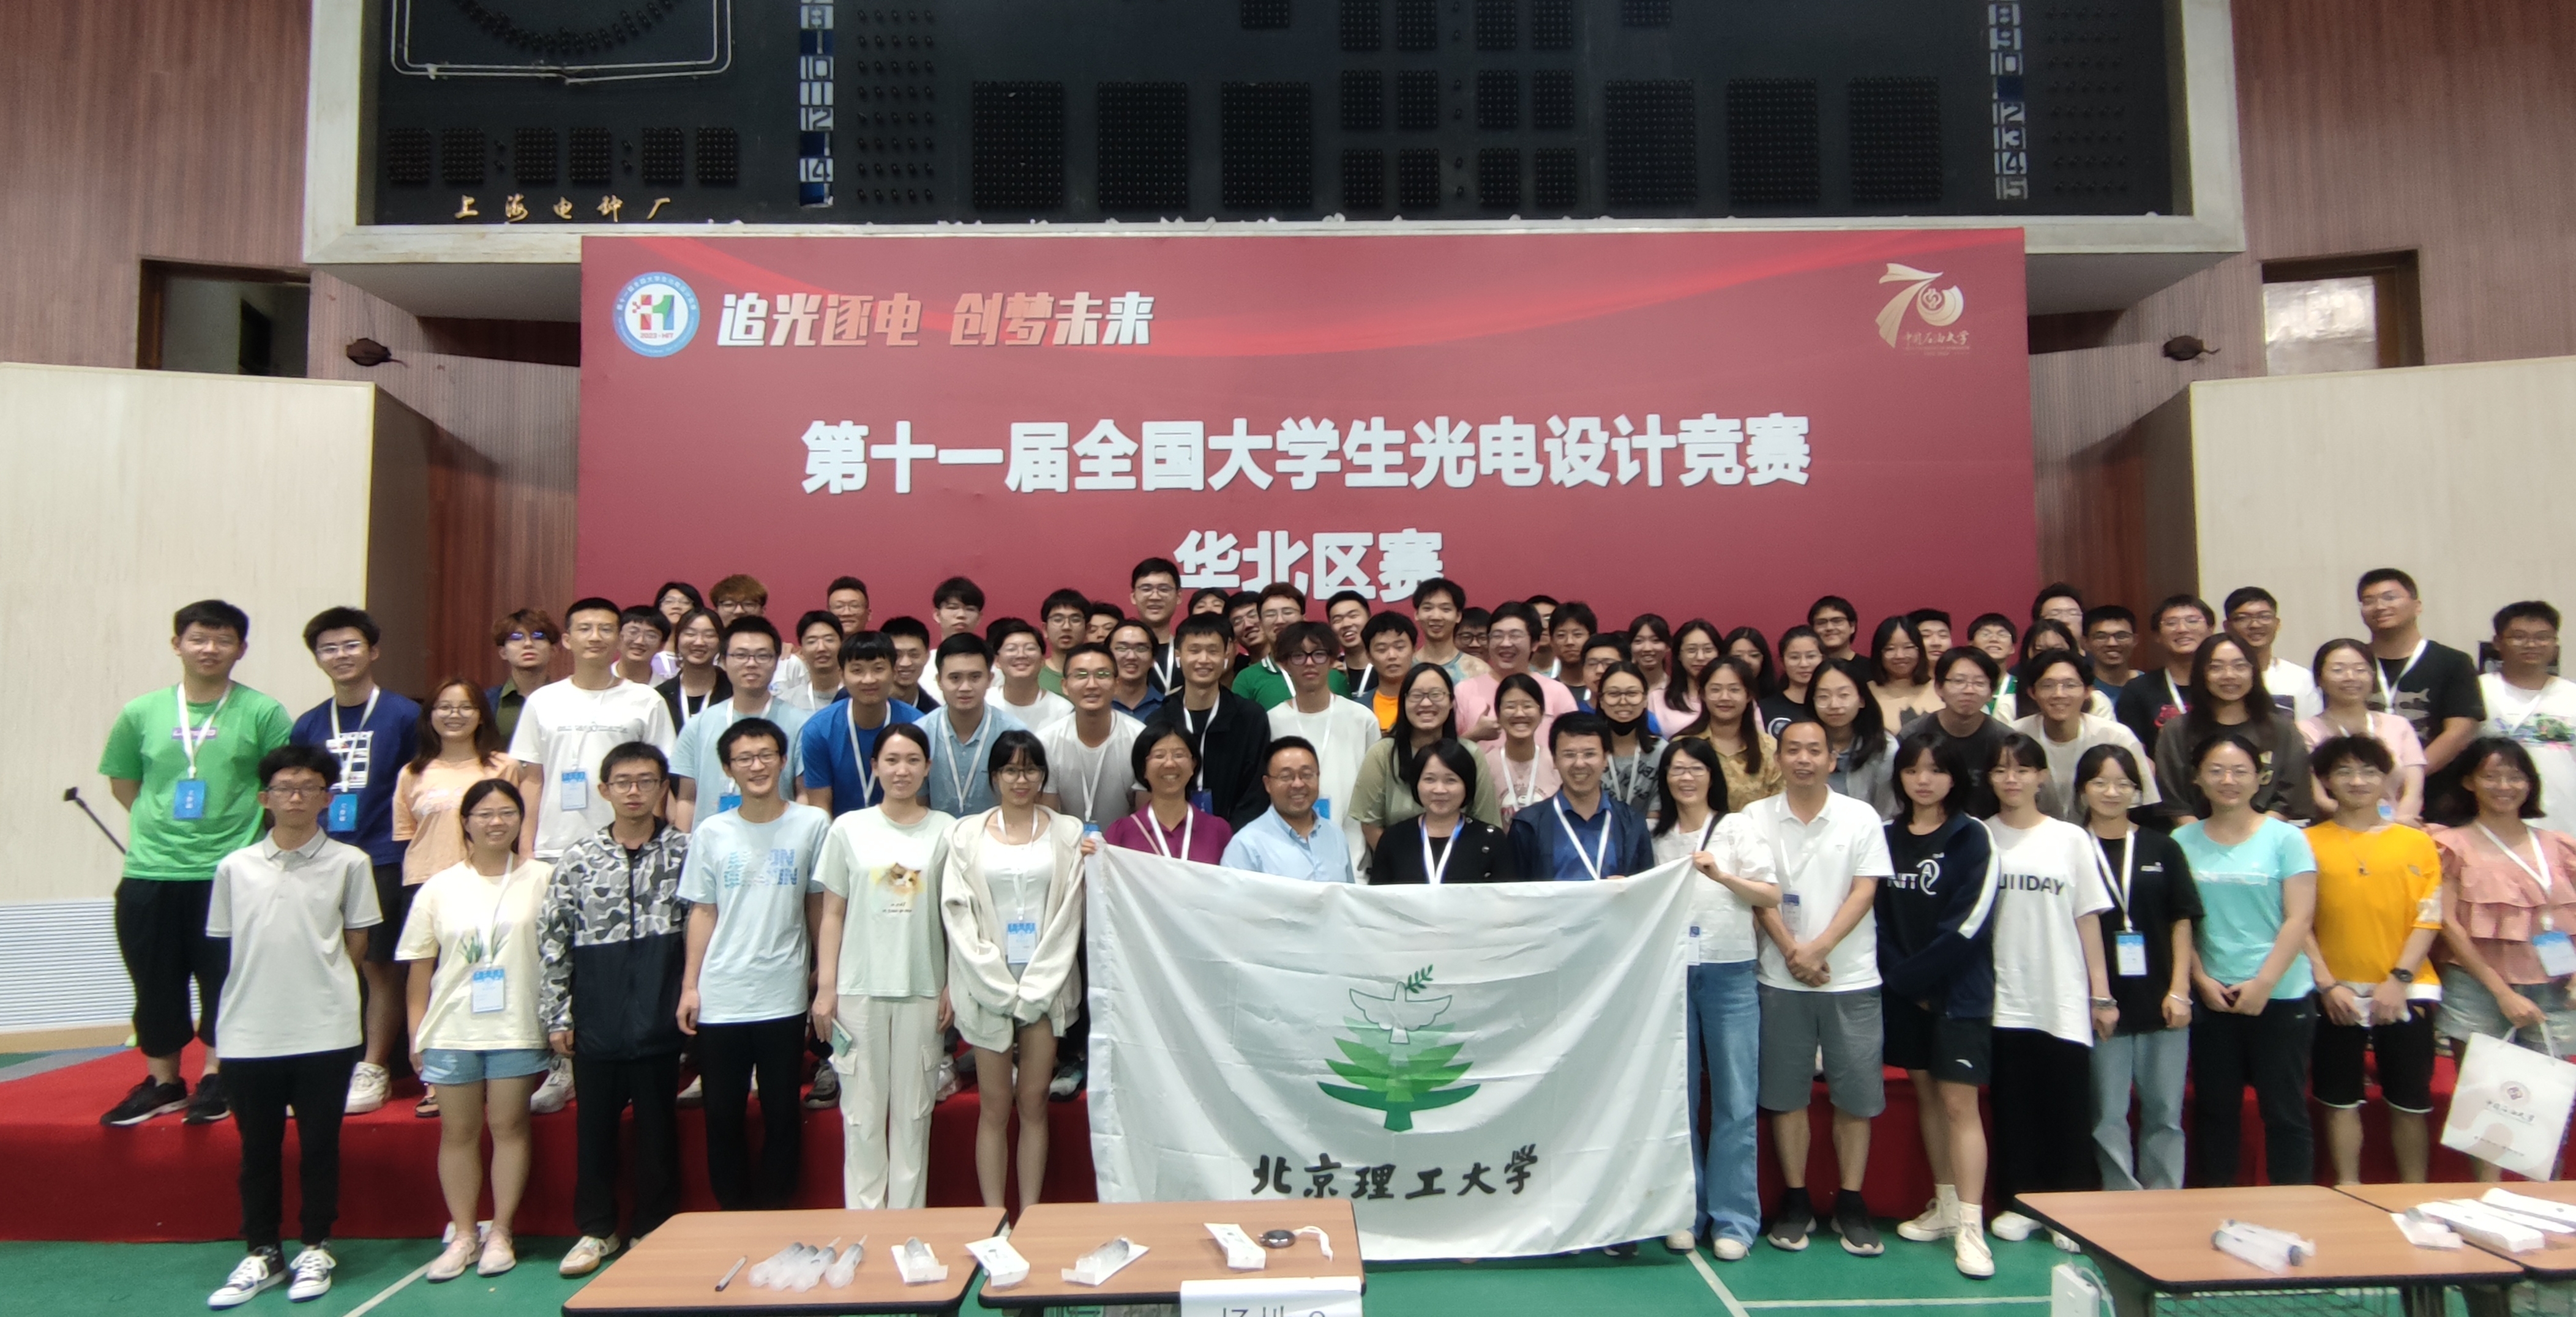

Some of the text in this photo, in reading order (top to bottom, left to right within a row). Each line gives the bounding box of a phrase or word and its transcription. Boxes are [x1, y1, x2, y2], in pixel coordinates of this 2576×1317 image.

[805, 107, 831, 130] 12
[805, 158, 831, 182] 14
[717, 293, 922, 346] 追光逐电
[949, 291, 1155, 346] 创梦未来
[801, 412, 1812, 494] 第十一届全国大学生光电设计竞赛
[1173, 528, 1444, 603] 华北区赛
[1251, 1143, 1538, 1200] 北京理工大学
